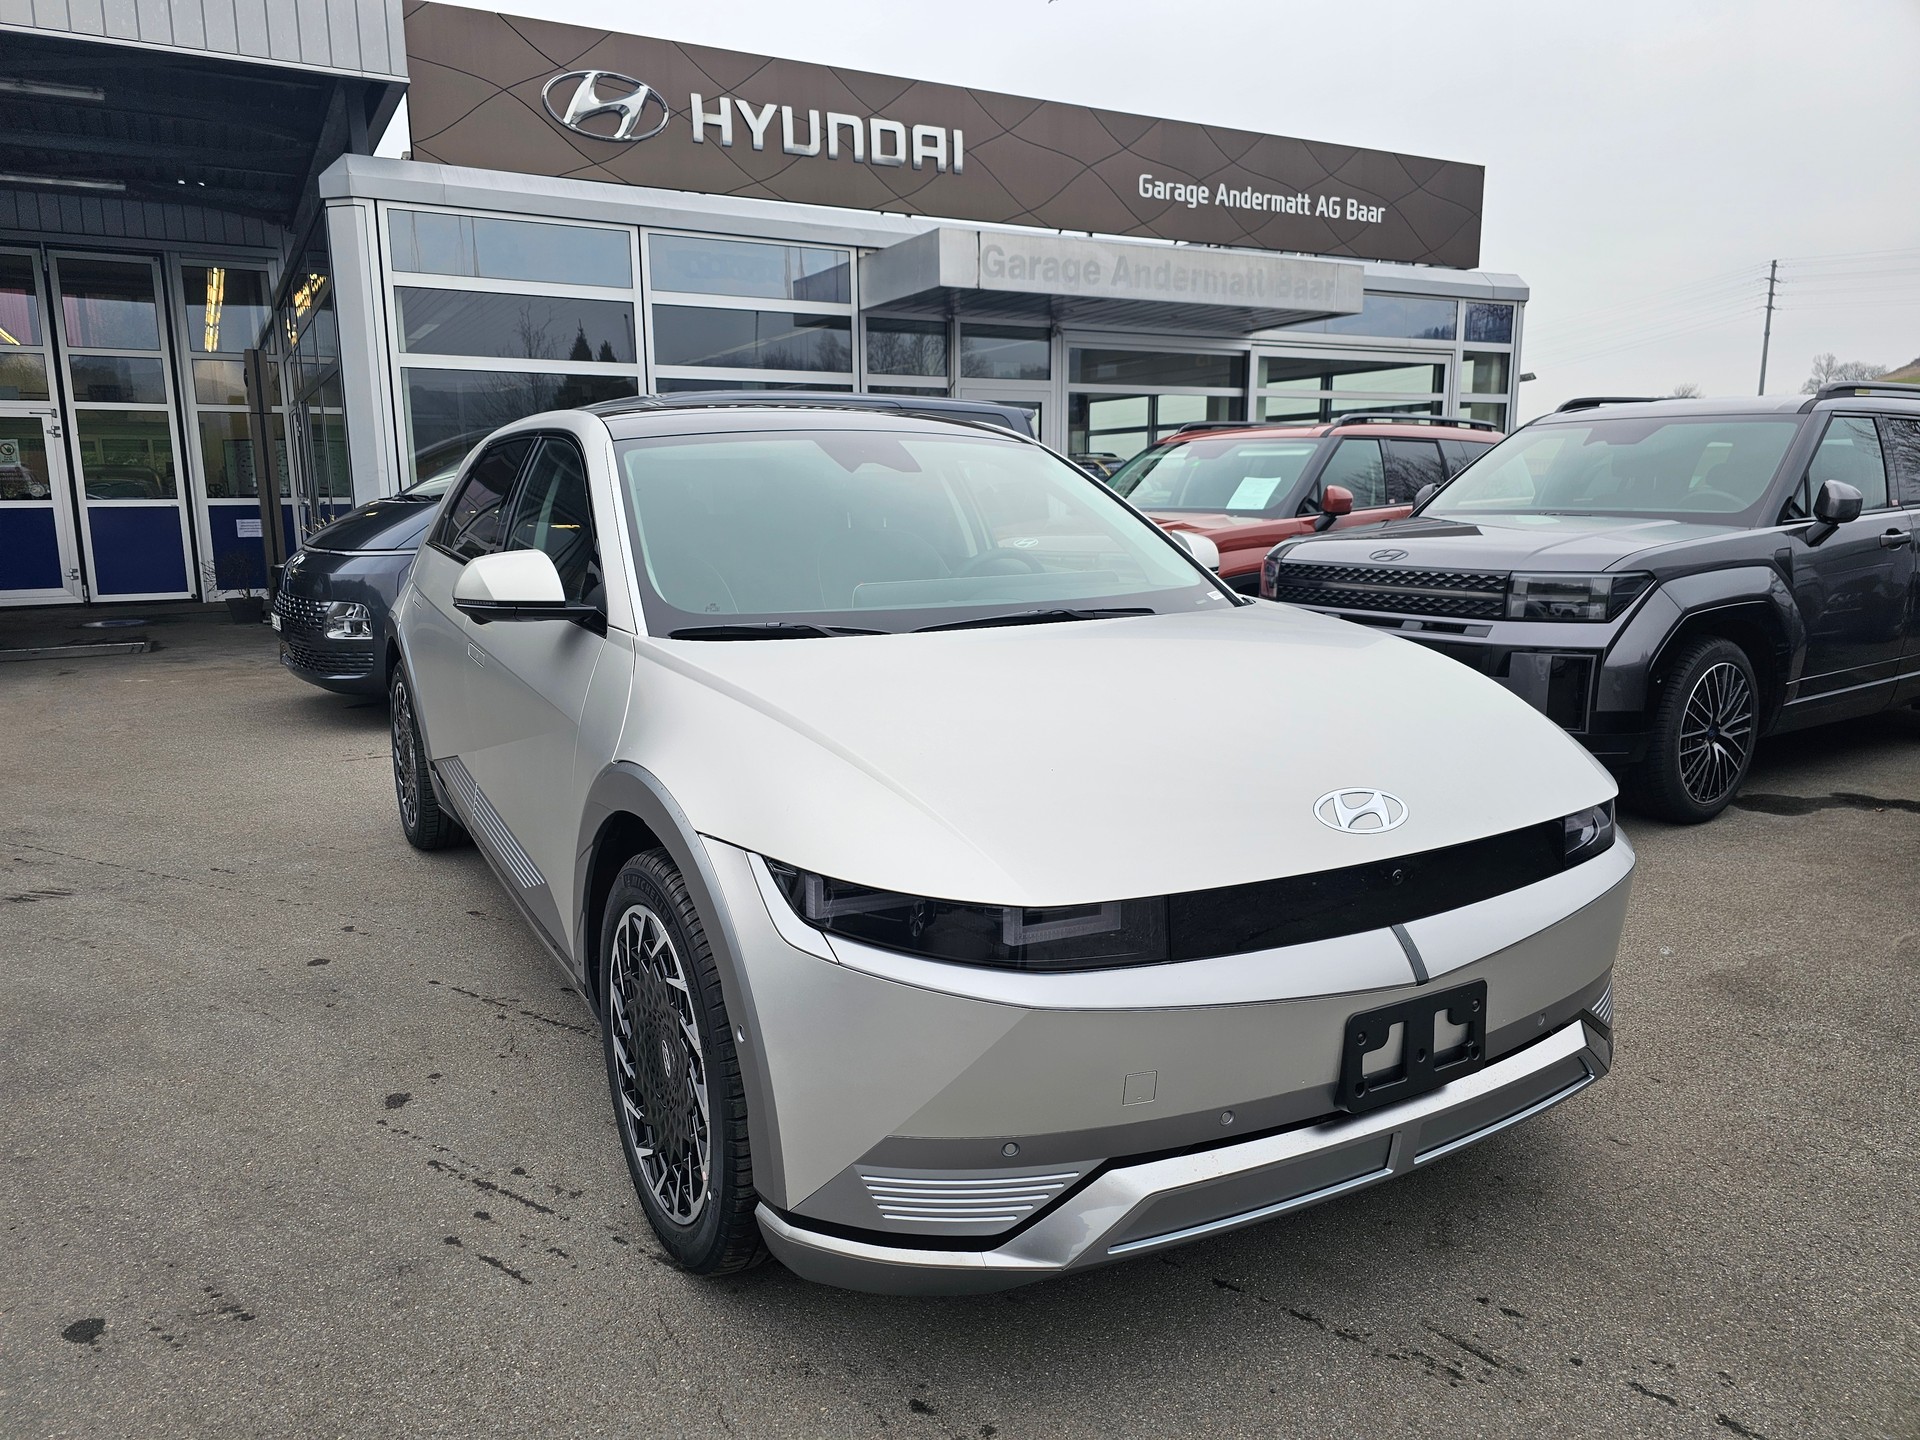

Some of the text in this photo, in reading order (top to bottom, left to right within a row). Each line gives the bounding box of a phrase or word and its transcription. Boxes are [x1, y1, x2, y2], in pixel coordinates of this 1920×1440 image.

[690, 93, 963, 175] HYUNDAI
[1138, 173, 1386, 224] Garage Andermatt AG Baar
[981, 244, 1336, 302] Garage Andermatt Baar
